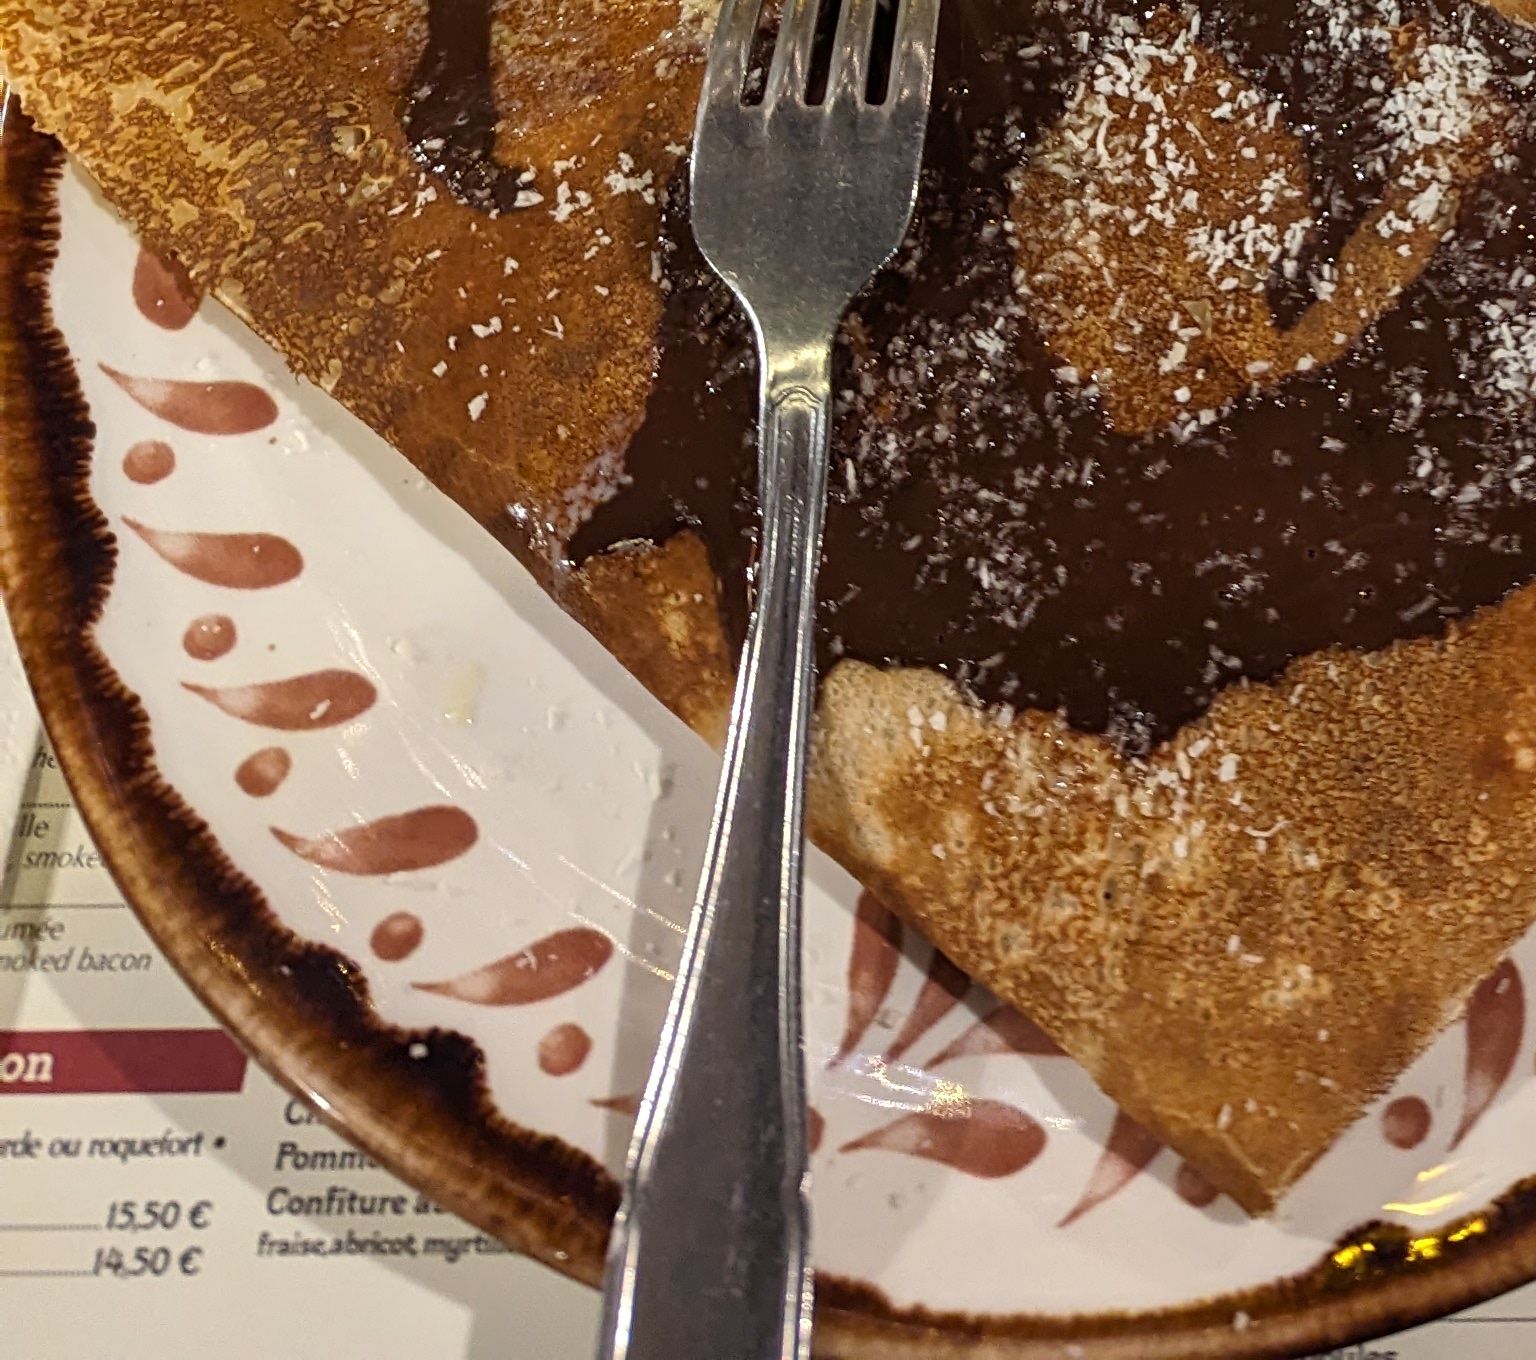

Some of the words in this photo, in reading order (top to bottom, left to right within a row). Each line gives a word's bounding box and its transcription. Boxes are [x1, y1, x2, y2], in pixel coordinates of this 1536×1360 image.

[77, 945, 154, 974] bacon
[188, 1199, 215, 1231] €
[266, 1185, 408, 1216] Confiture
[178, 1245, 204, 1277] €
